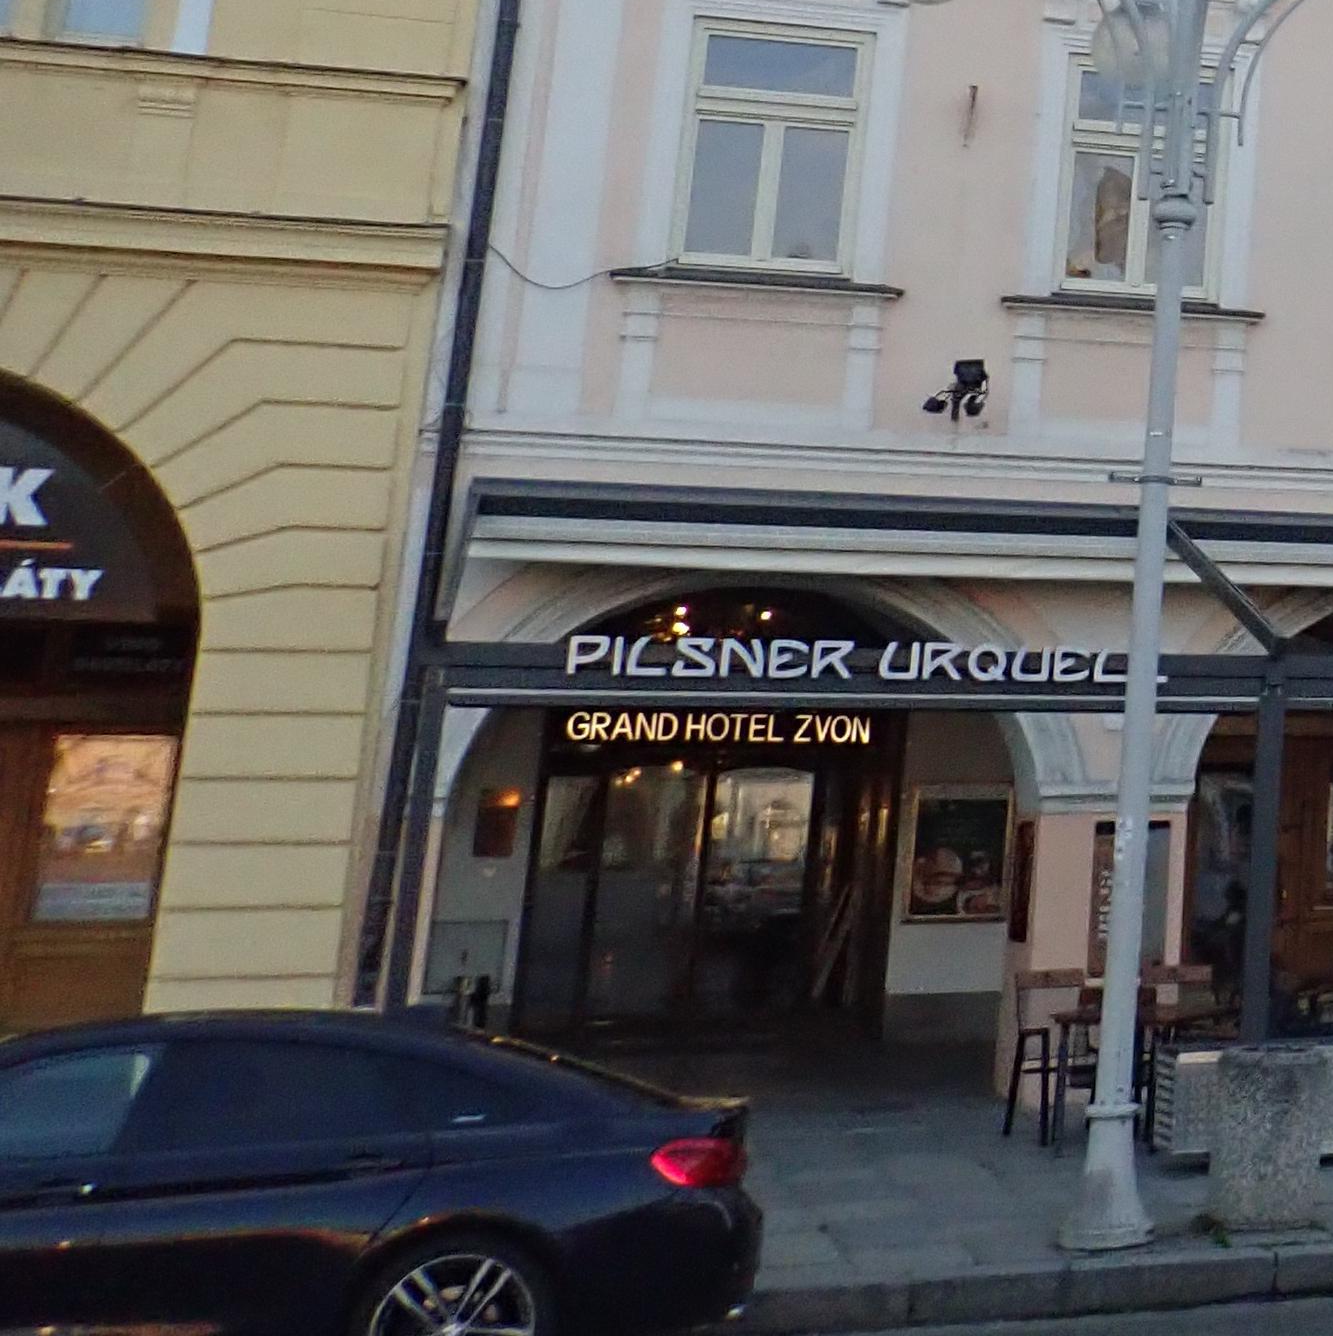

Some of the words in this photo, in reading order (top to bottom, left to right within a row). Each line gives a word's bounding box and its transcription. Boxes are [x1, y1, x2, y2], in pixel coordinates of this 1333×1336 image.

[0, 558, 105, 600] ÁTY
[566, 634, 855, 680] PILSNER
[879, 640, 1168, 683] URQUEL
[567, 711, 679, 742] GRAND
[684, 714, 784, 743] HOTEL
[793, 715, 871, 745] ZVON
